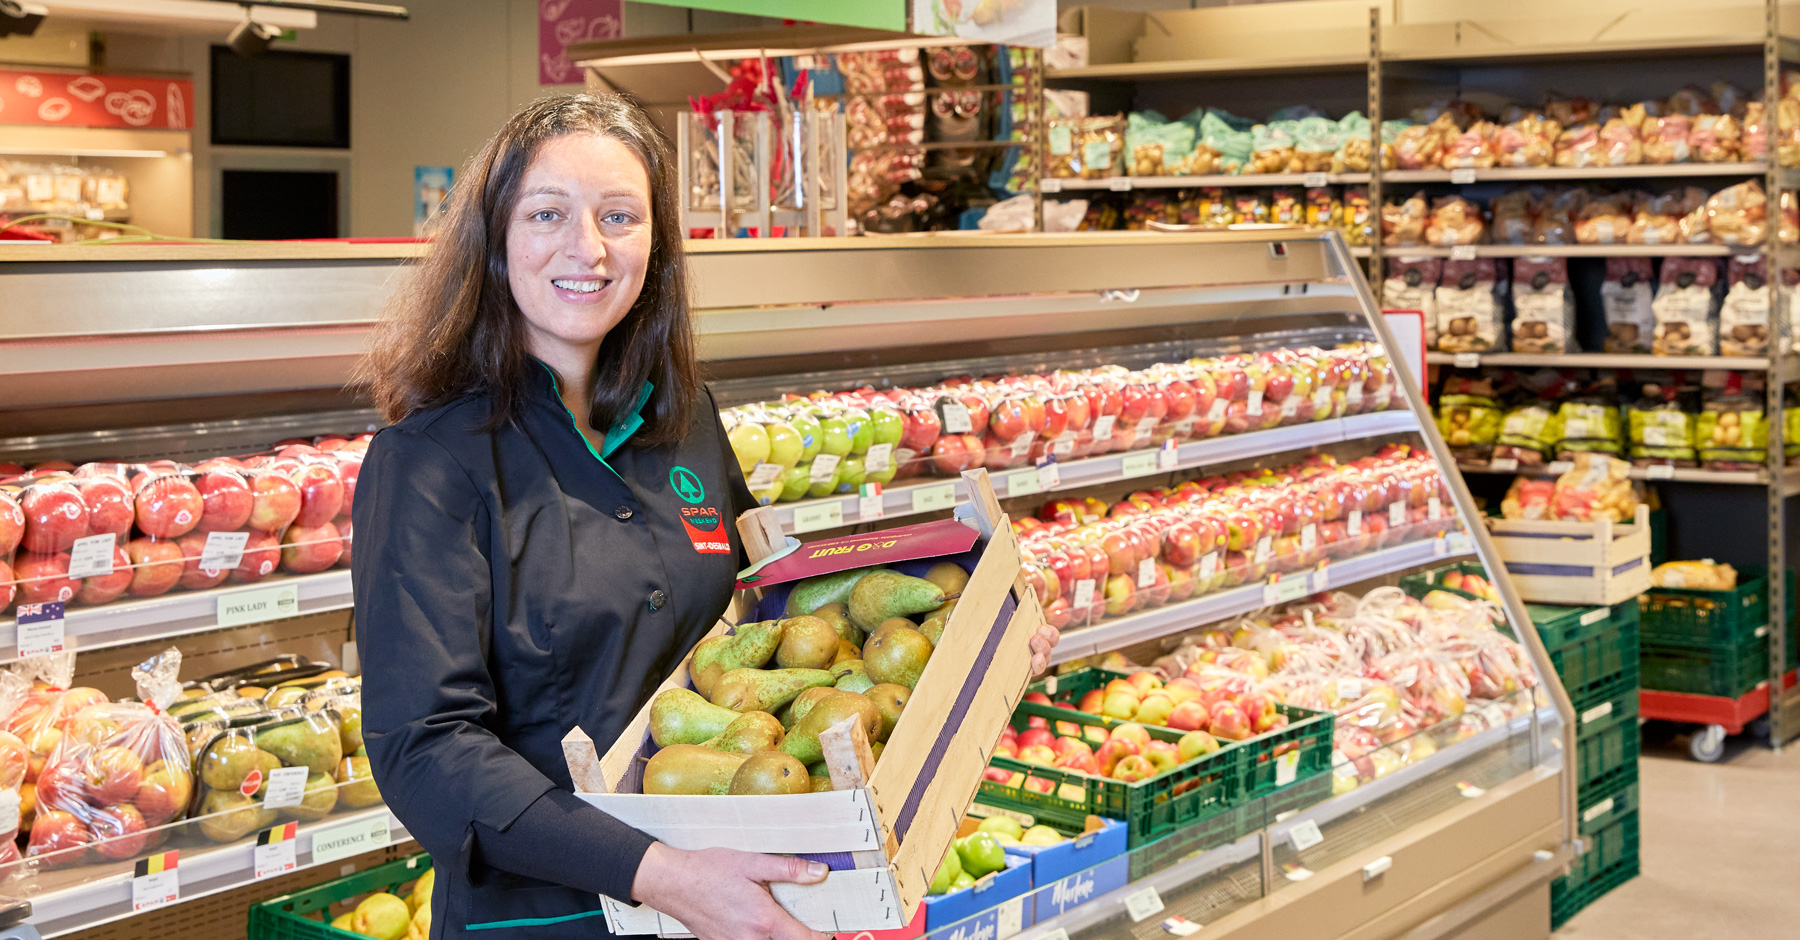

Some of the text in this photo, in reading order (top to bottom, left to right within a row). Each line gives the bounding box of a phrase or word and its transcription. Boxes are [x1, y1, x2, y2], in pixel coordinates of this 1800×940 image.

[681, 507, 718, 516] SPAR
[809, 545, 855, 559] FRUIT
[857, 540, 898, 551] D&G
[226, 602, 267, 615] PINK LADY
[316, 833, 365, 853] CONFERENCE
